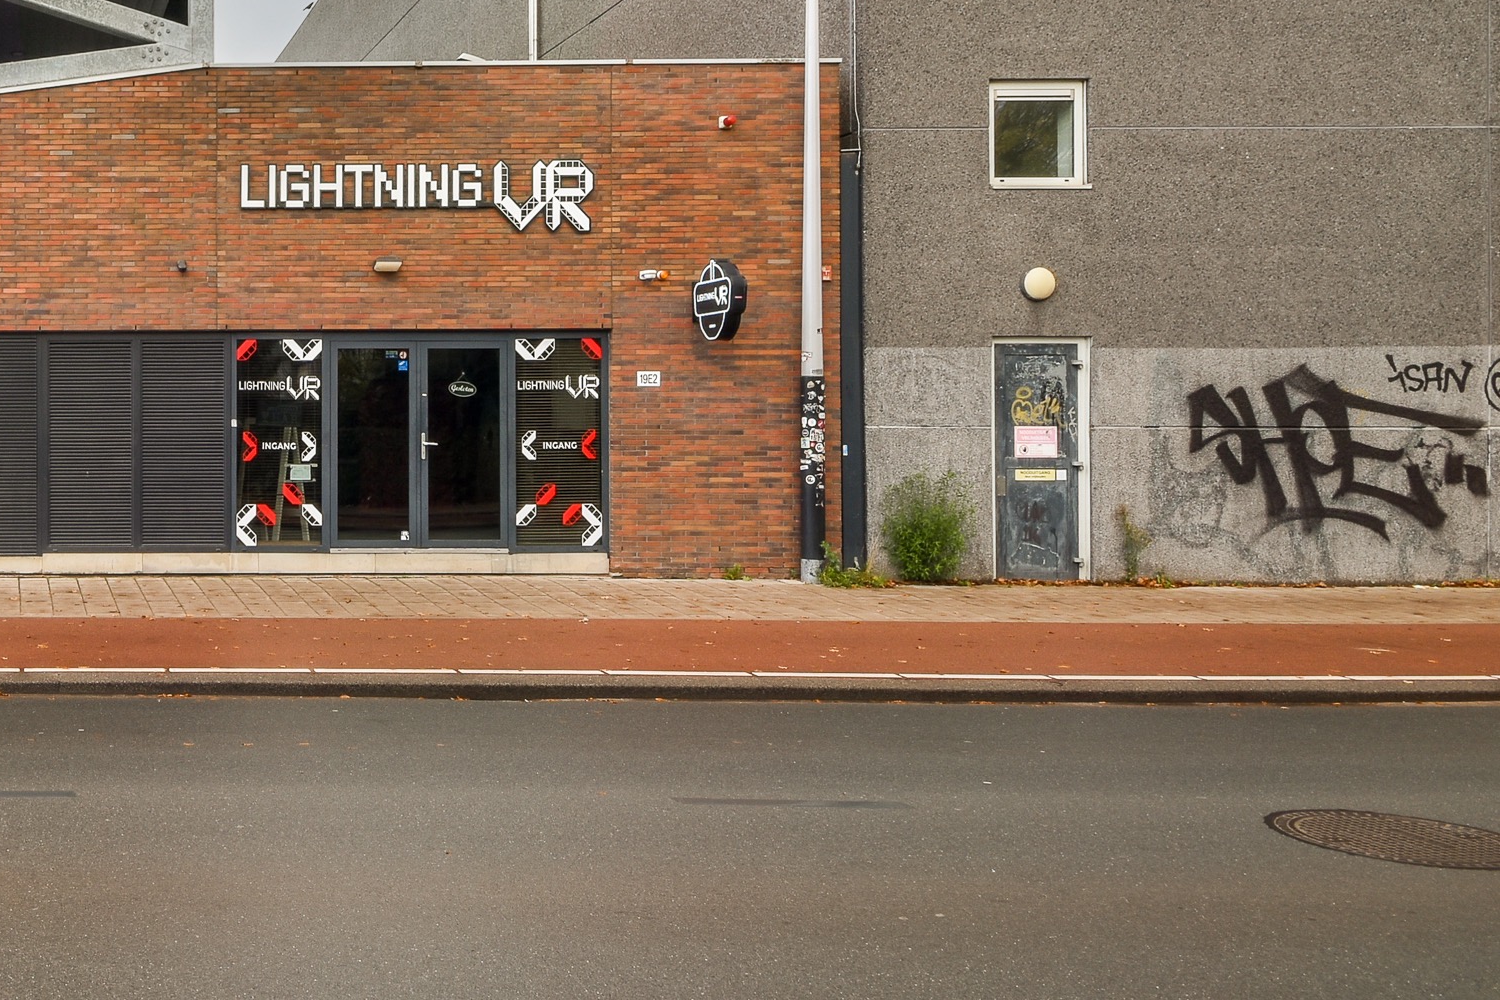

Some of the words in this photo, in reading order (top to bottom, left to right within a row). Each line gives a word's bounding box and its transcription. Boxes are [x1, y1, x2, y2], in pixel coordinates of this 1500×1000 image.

[240, 163, 483, 208] LIGHTNING
[493, 159, 595, 232] VR
[714, 285, 728, 306] VR
[238, 380, 286, 391] LIGHTNING
[286, 375, 320, 400] VR
[517, 380, 565, 391] LIGHTNING
[565, 374, 600, 399] VR
[640, 373, 658, 384] 19E2
[262, 442, 297, 450] INGANG
[542, 442, 578, 450] INGANG
